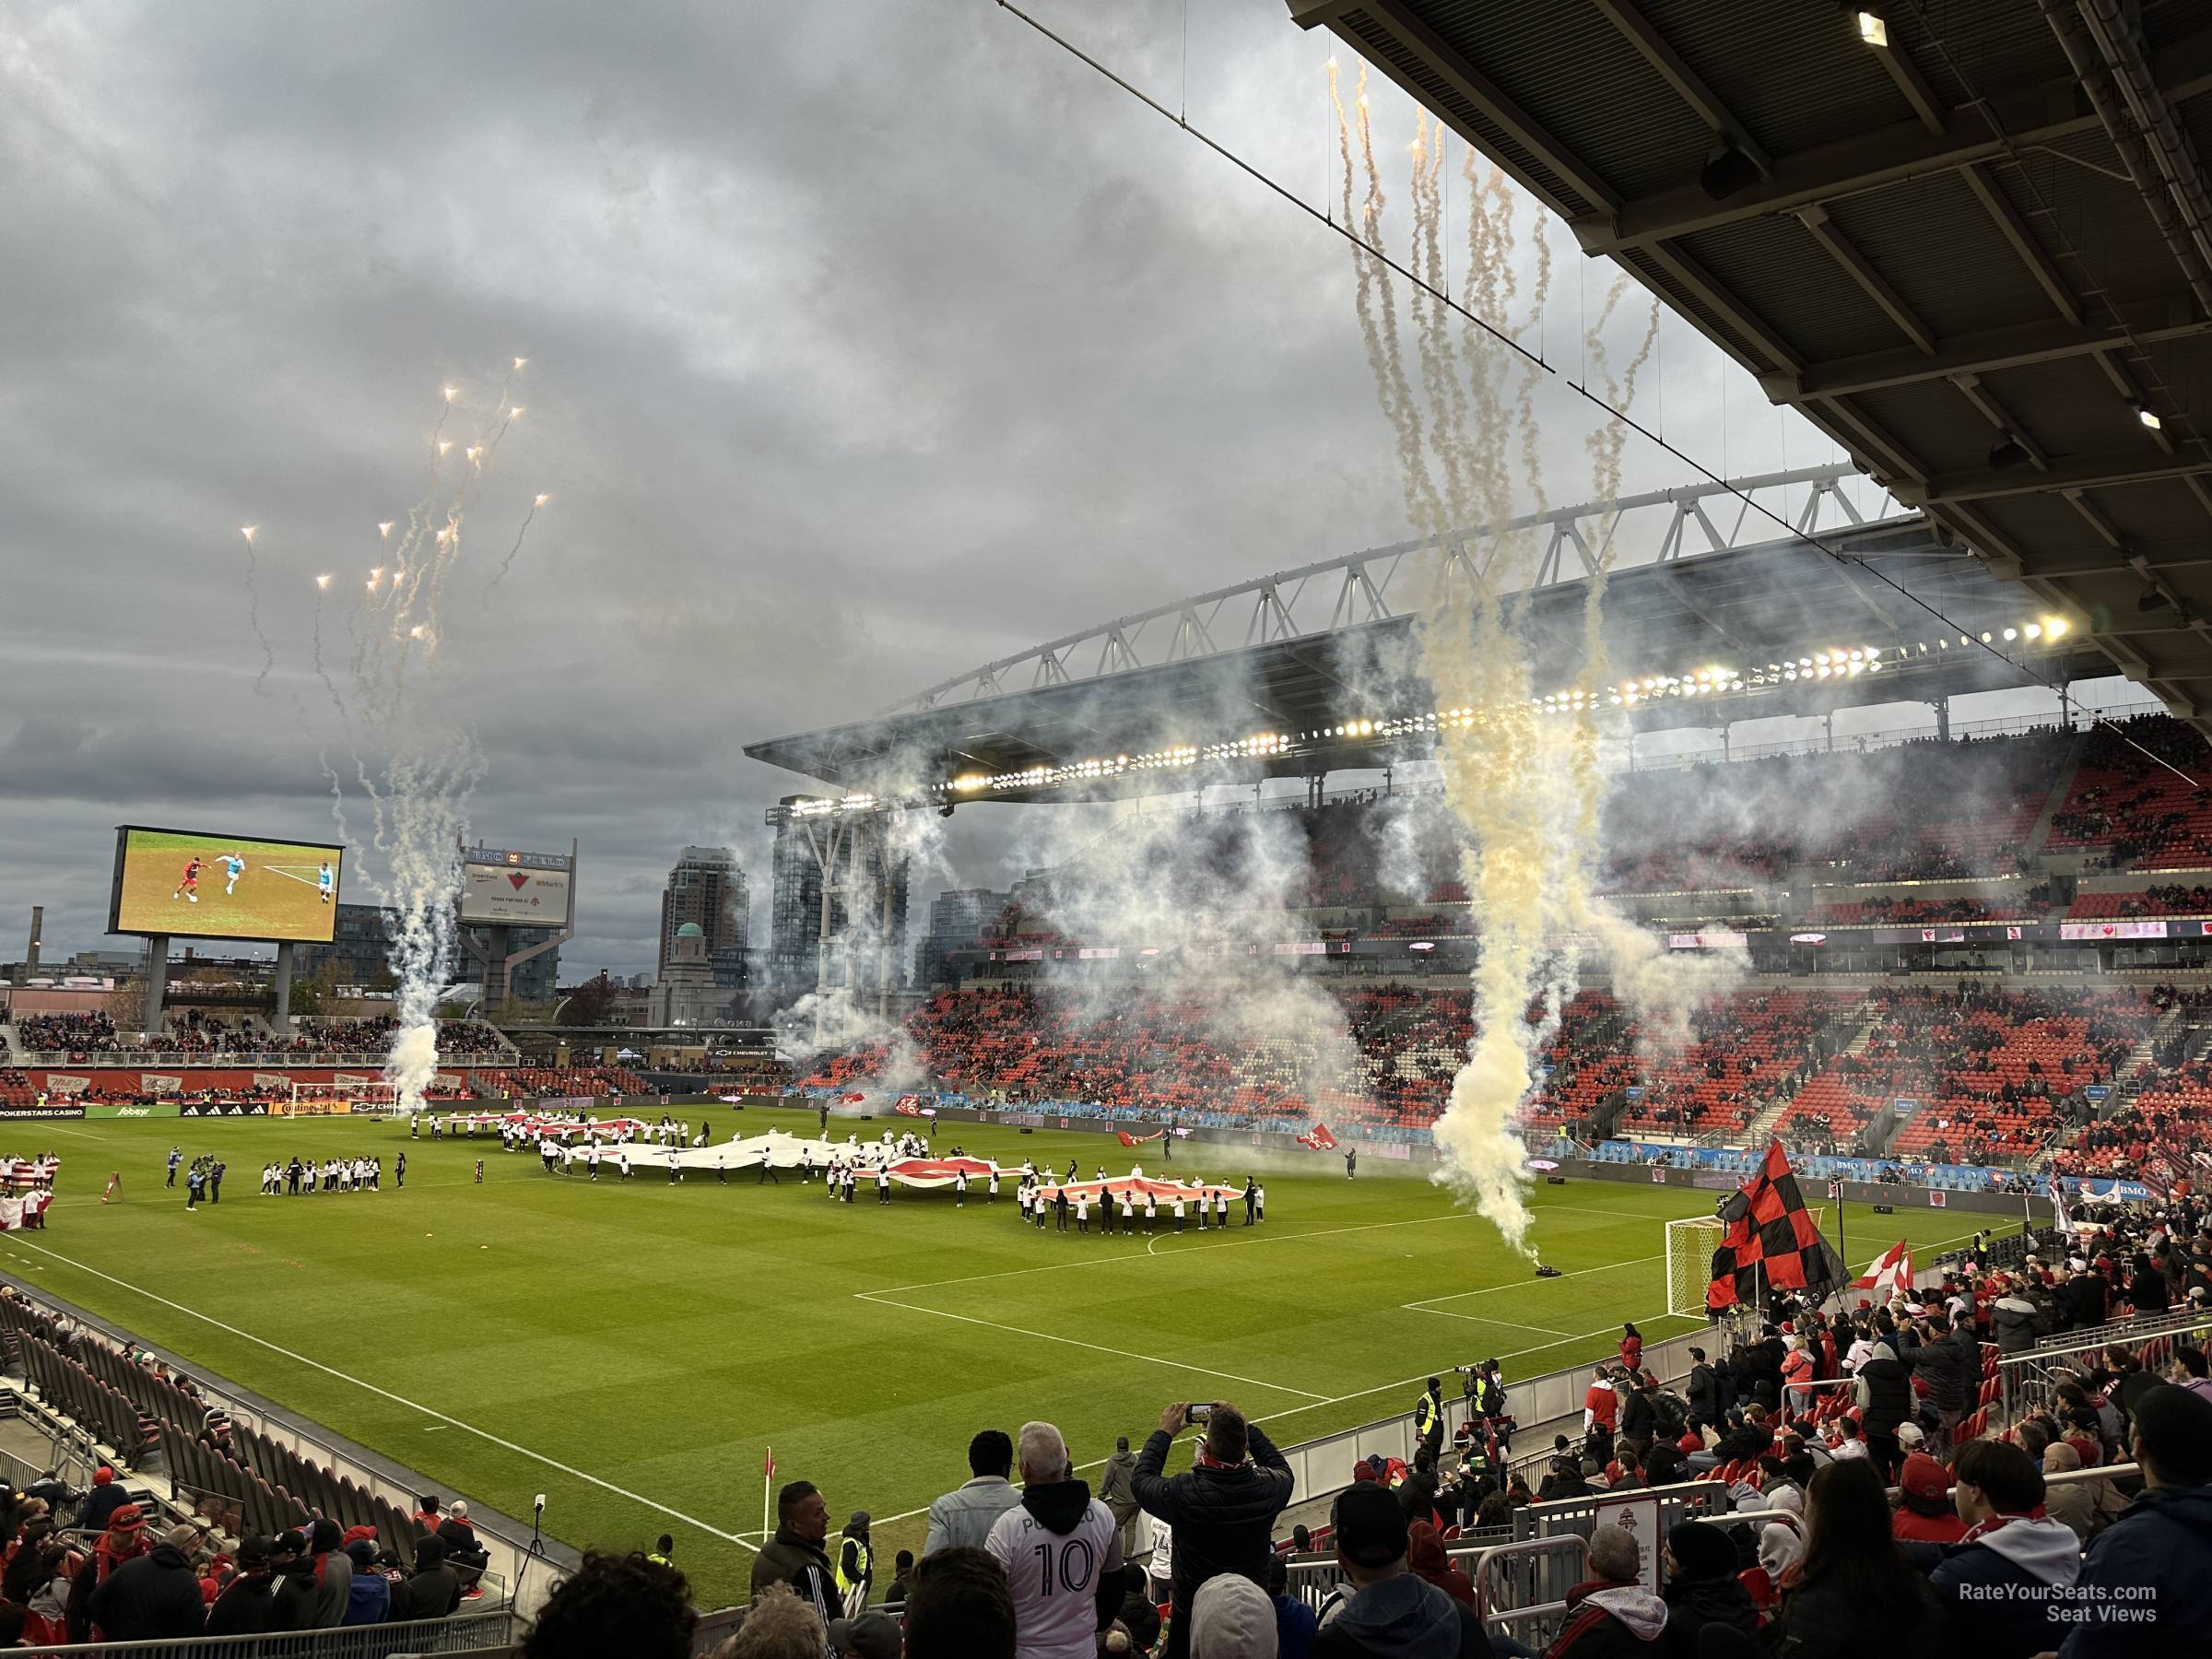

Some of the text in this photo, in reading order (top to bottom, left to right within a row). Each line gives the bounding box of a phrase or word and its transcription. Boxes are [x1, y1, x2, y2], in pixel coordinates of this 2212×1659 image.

[472, 850, 565, 866] BMO FIELD
[1836, 1161, 1858, 1170] BMO
[2121, 1185, 2147, 1195] BMO
[1034, 1537, 1094, 1597] 10
